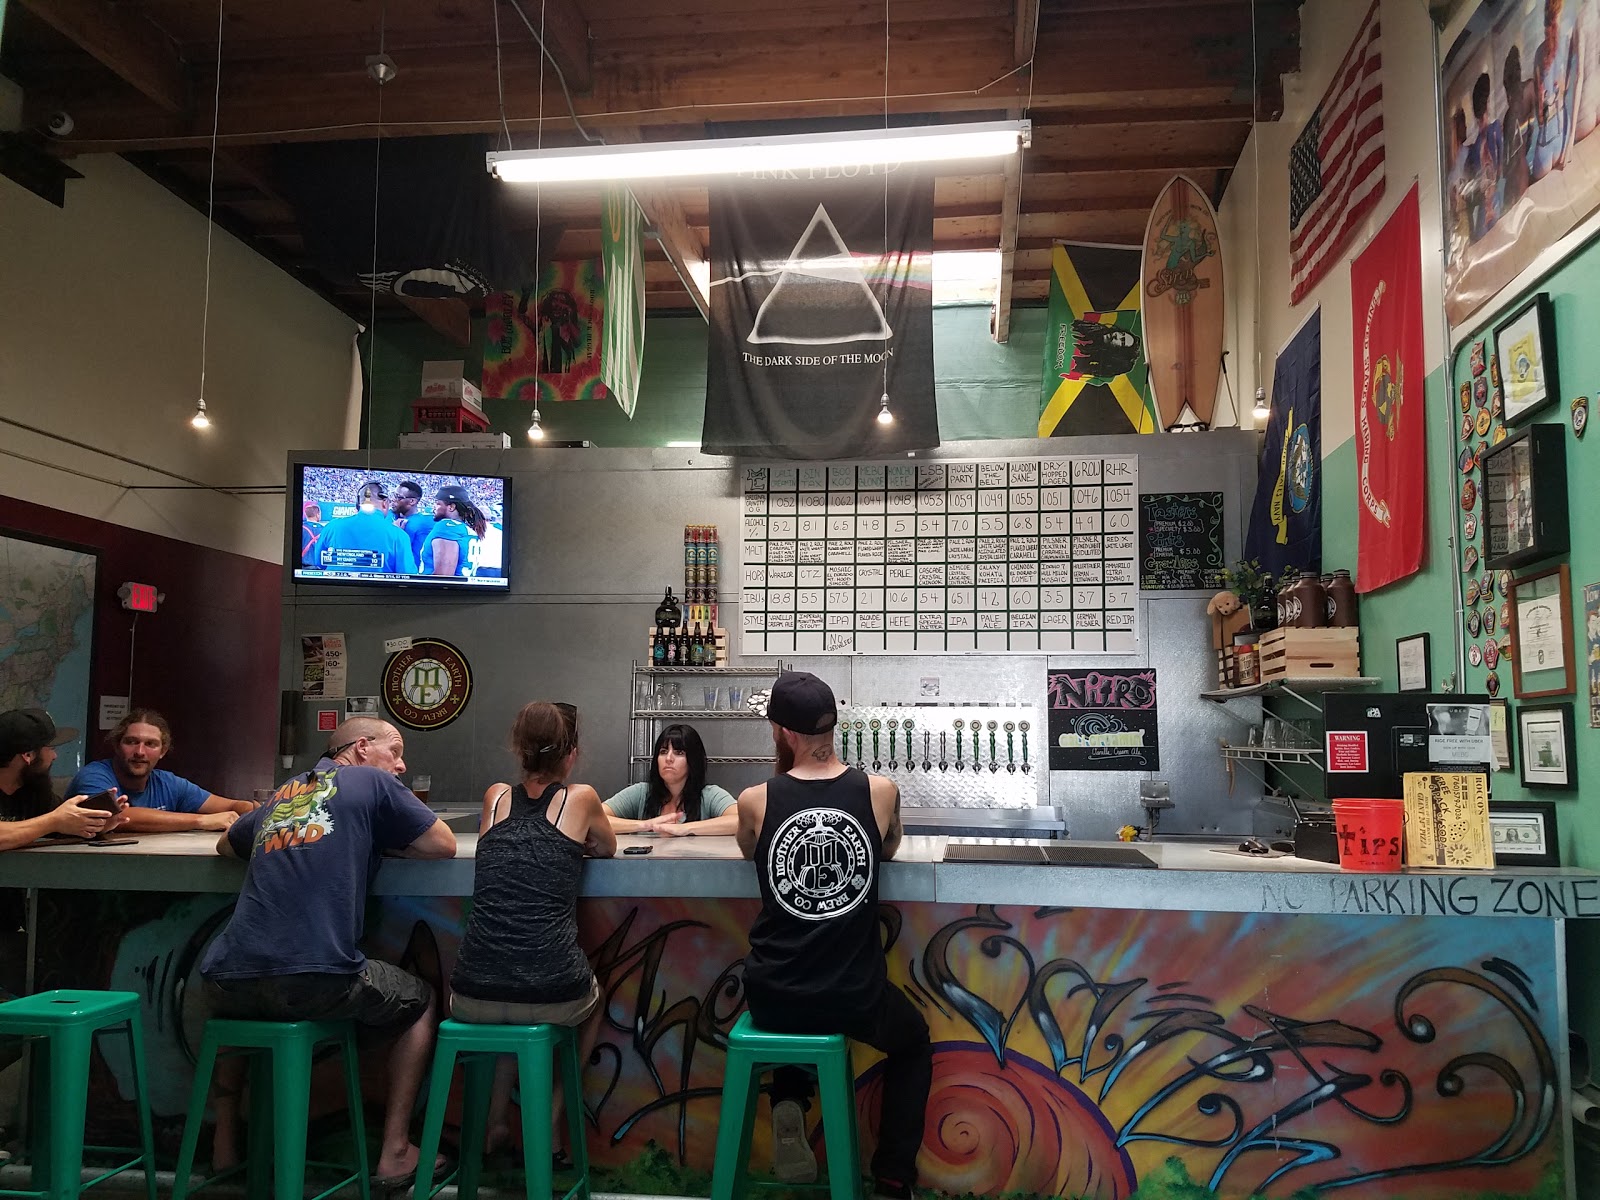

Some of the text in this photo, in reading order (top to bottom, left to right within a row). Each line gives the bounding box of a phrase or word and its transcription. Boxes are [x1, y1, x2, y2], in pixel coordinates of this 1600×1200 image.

[742, 347, 894, 366] THE DARK SIDE OF THE MOON
[920, 464, 944, 476] ESB
[951, 464, 974, 473] HOUSE
[980, 463, 1006, 472] BELOW
[1010, 463, 1037, 472] ALADDIN
[1105, 462, 1132, 476] RHR
[950, 474, 974, 484] PARTY
[979, 478, 1002, 486] BELT
[1010, 473, 1036, 483] SANE
[1042, 477, 1069, 485] LAGER
[1361, 476, 1379, 515] CORPS
[1273, 501, 1282, 522] NAVY
[745, 518, 766, 527] ALCOHOL
[833, 520, 849, 531] 6.5
[894, 519, 906, 532] 5
[920, 519, 940, 531] 5.4
[951, 519, 969, 532] 7.0
[1013, 517, 1033, 530] 6.8
[1042, 536, 1068, 544] PILSNER
[744, 545, 764, 556] MALT
[745, 569, 765, 582] HOPS
[768, 569, 794, 579] WARRIOR
[800, 569, 822, 579] CTZ
[858, 568, 883, 577] CRYSTAL
[889, 568, 913, 578] PERLE
[1012, 591, 1032, 605] 60
[1078, 591, 1095, 605] 37
[744, 615, 764, 626] STYLE
[828, 615, 849, 625] IPA
[889, 616, 912, 627] HEFE
[948, 616, 968, 626] IPA
[980, 614, 1002, 623] PALE
[1010, 613, 1037, 621] BELGIAN
[1042, 614, 1069, 625] LAGER
[1076, 613, 1097, 621] GERMAN
[1106, 615, 1135, 624] RED IPA
[860, 621, 881, 629] ALE
[1012, 620, 1034, 628] IPA
[1075, 619, 1101, 627] PILSNER
[391, 654, 462, 692] MOTHER EARTH
[403, 705, 448, 722] BREW CO.
[1435, 776, 1452, 795] FREE
[1475, 777, 1486, 816] ROCCO'S
[1417, 792, 1425, 815] GIANT
[1432, 791, 1452, 814] PACK
[265, 823, 324, 854] WILD
[1419, 829, 1427, 850] PIZZA
[1438, 824, 1447, 850] SODA
[776, 825, 866, 878] MOTHER EARTH
[794, 891, 851, 912] BREW CO.
[1329, 876, 1479, 916] PARKING
[1490, 878, 1600, 917] ZONE
